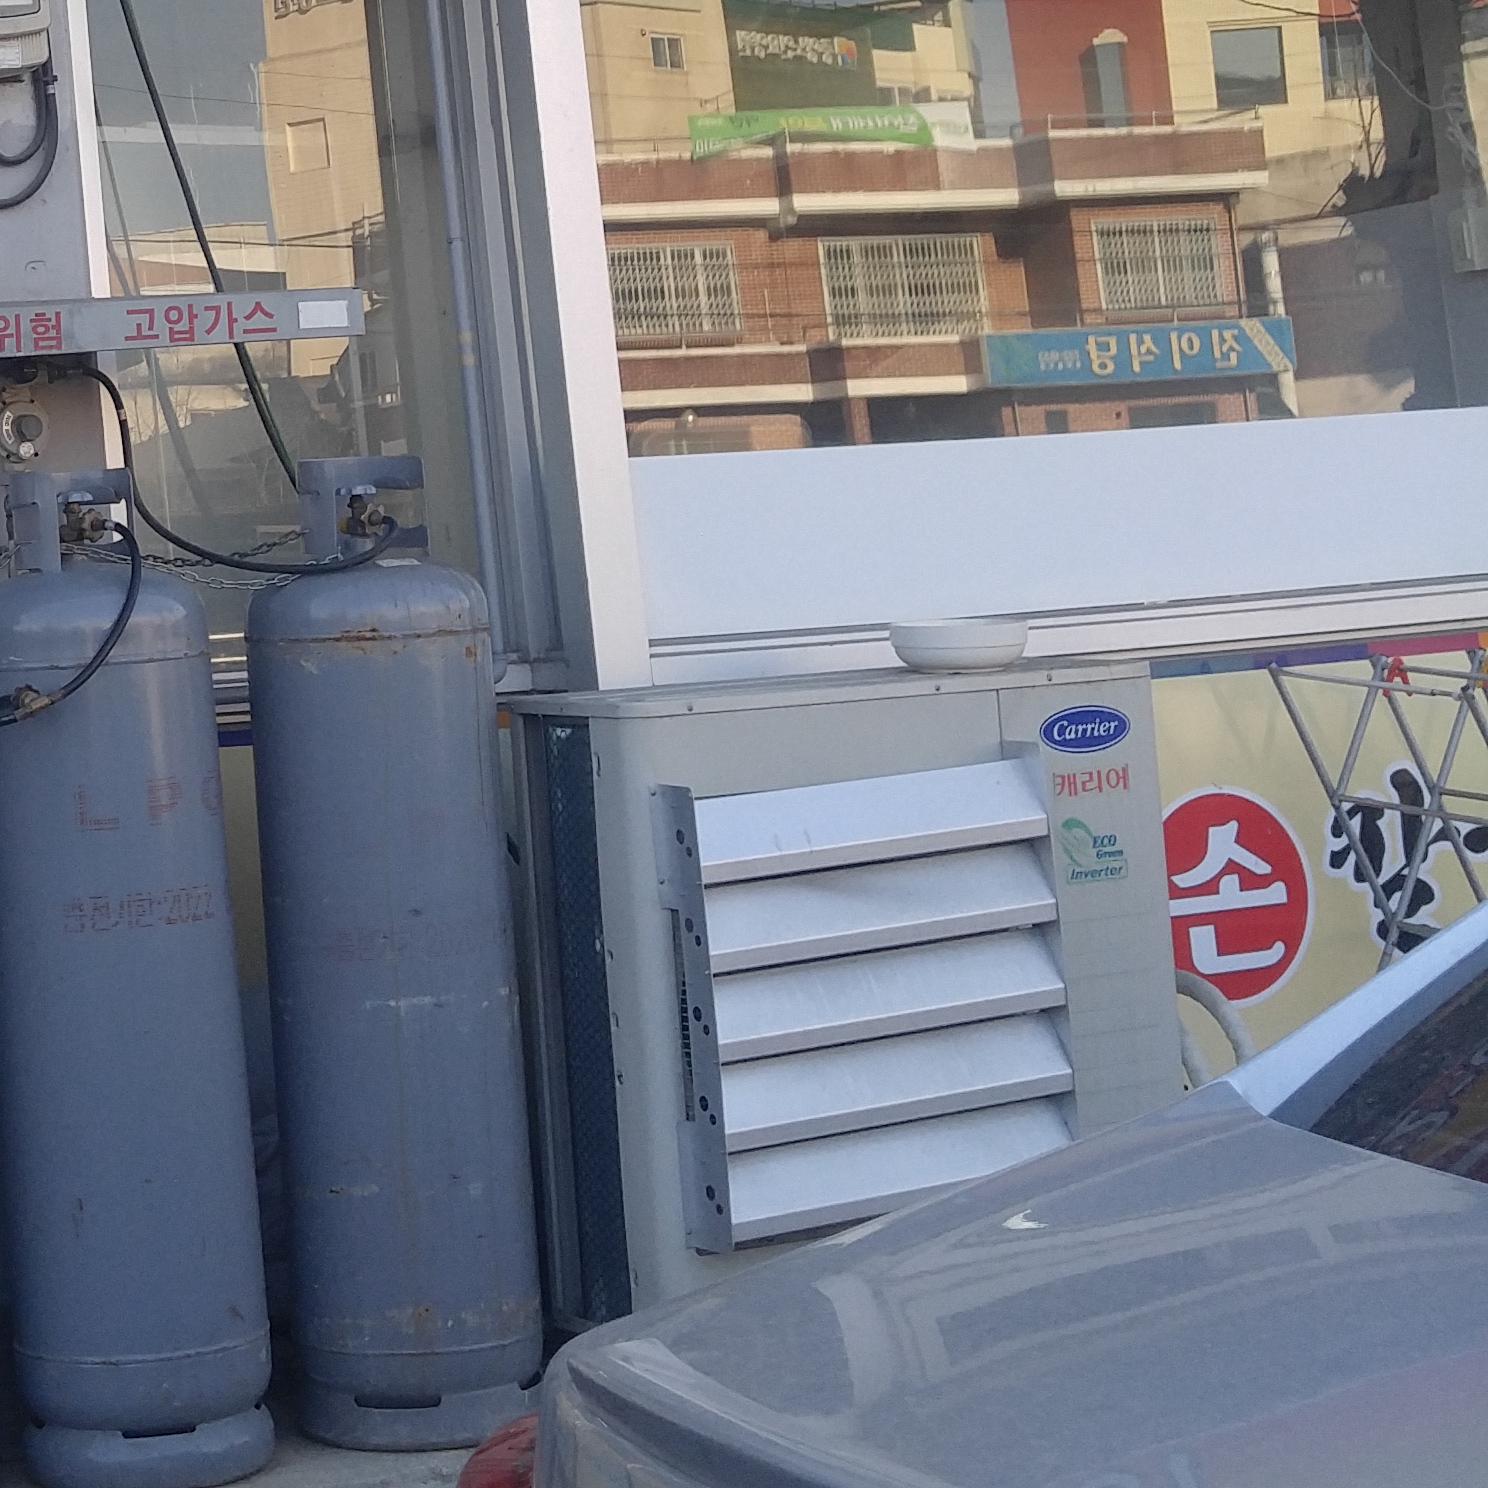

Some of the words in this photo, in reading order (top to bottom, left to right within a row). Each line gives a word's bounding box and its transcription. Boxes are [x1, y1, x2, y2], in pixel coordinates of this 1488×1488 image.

[124, 300, 278, 344] 고압가스
[1053, 717, 1119, 742] Carrier
[1054, 764, 1130, 797] 캐리어
[1092, 834, 1117, 849] ECO
[1096, 849, 1123, 859] Green
[1070, 864, 1124, 881] Inverter
[1169, 818, 1289, 975] 손
